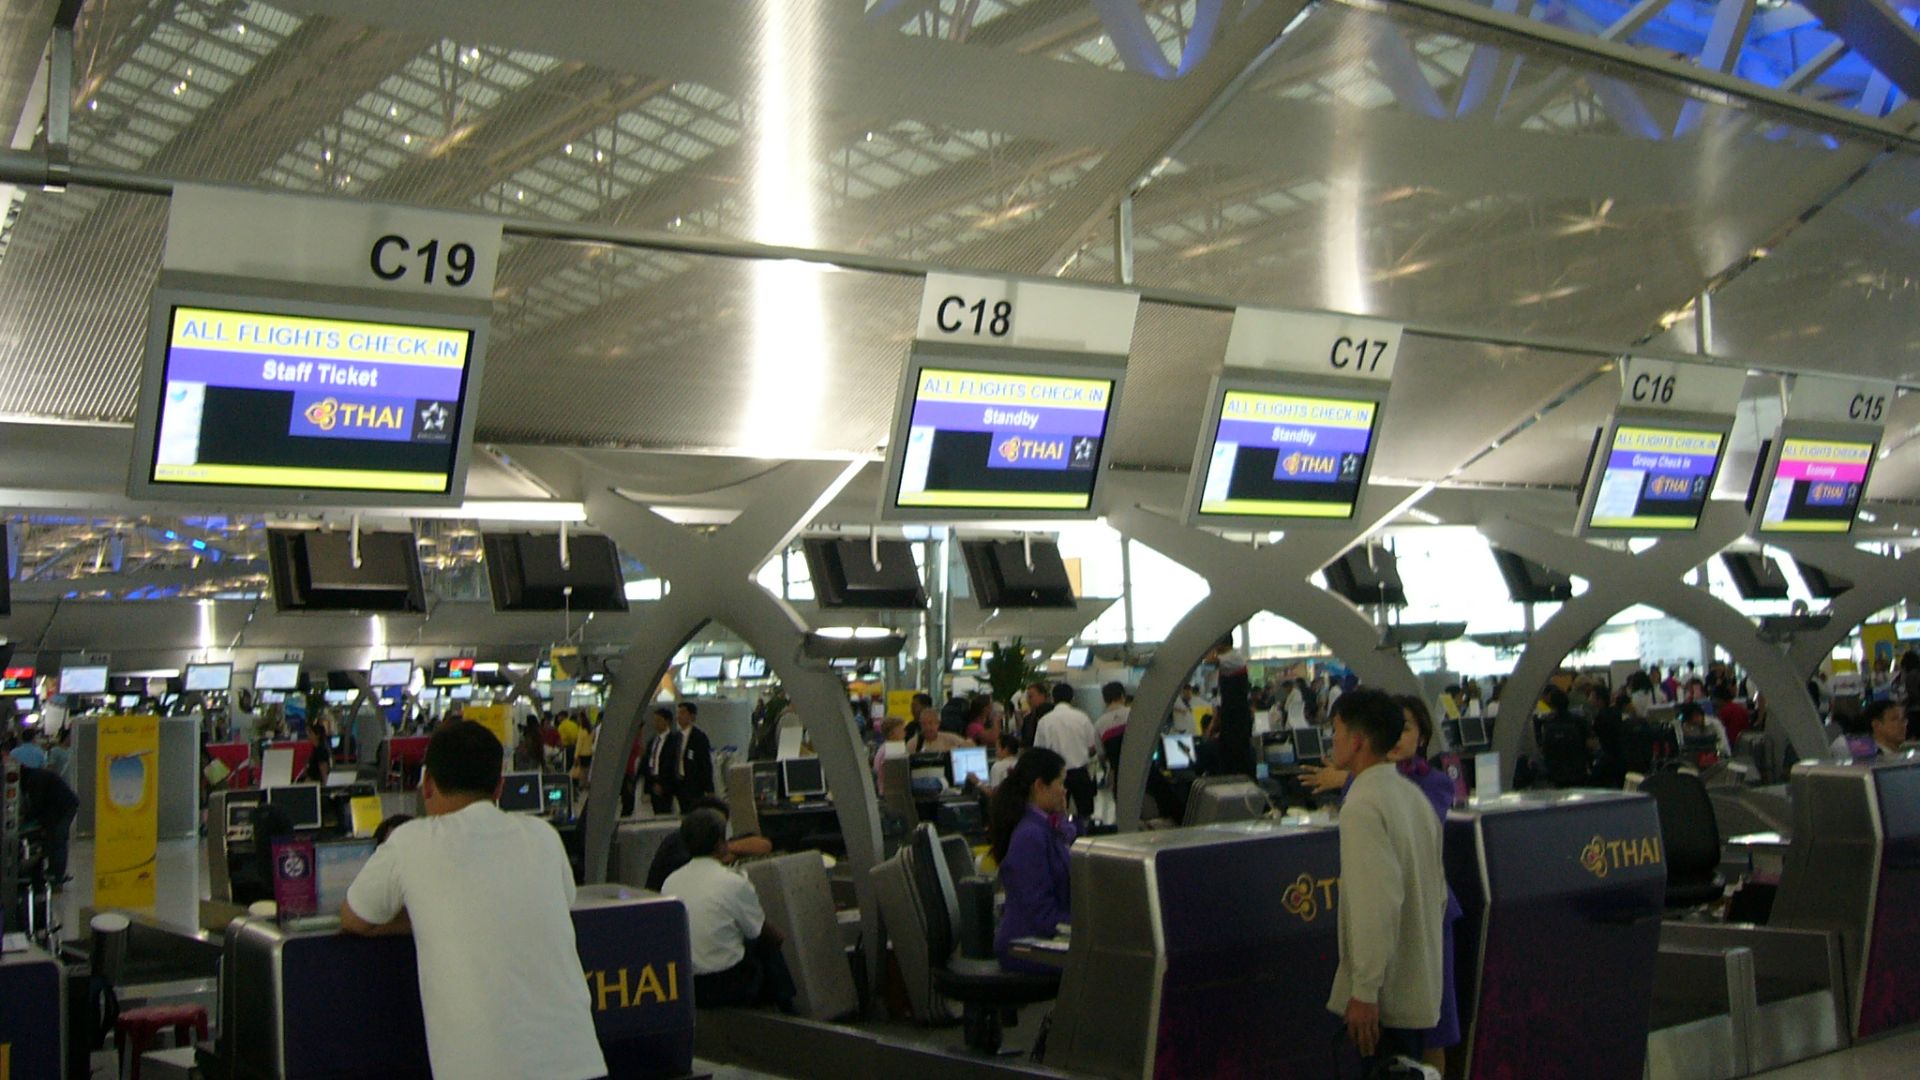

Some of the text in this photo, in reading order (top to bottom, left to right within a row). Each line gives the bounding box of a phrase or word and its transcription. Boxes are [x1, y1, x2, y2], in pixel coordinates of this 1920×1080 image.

[369, 235, 476, 287] C19
[937, 296, 1012, 337] C18
[182, 320, 229, 341] ALL
[238, 324, 340, 350] FLIGHTS
[1330, 337, 1388, 372] C17
[262, 359, 378, 388] Staff Ticket
[924, 378, 953, 394] ALL
[960, 380, 1026, 398] FLIGHTS
[1633, 373, 1675, 403] C16
[340, 404, 403, 429] THAI
[983, 408, 1039, 430] Standby
[1227, 400, 1250, 414] ALL
[1255, 402, 1308, 418] FLIGHTS
[1849, 394, 1885, 421] C15
[1272, 427, 1317, 447] Standby
[1022, 442, 1064, 460] THAI
[1632, 454, 1658, 469] Group
[1301, 456, 1334, 474] THAI
[1665, 480, 1688, 493] THAI
[1823, 485, 1842, 497] THAI
[1606, 837, 1660, 868] THAI
[585, 961, 679, 1011] HAI
